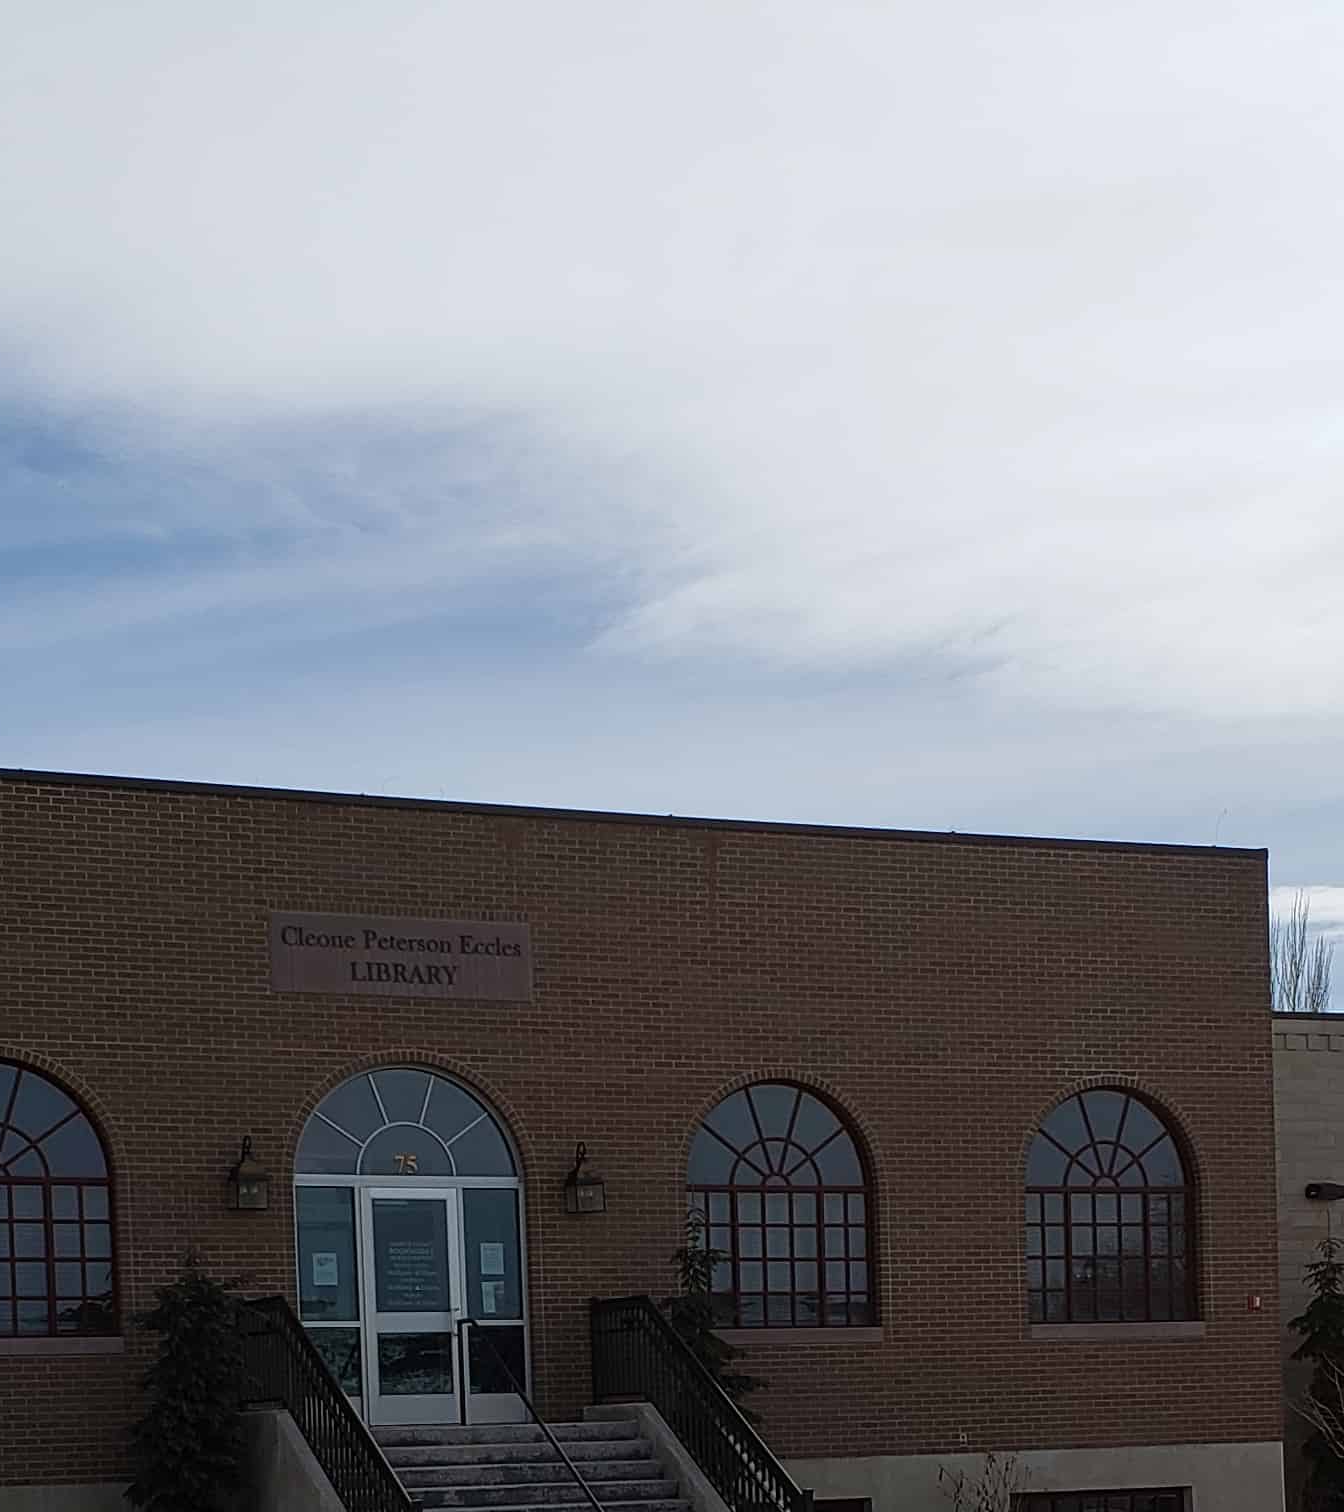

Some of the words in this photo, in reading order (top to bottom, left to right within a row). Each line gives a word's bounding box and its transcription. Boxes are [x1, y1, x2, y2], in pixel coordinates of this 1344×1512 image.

[281, 926, 356, 949] Cleone
[362, 930, 453, 953] Peterson
[459, 936, 522, 957] Eccles
[350, 962, 459, 986] LIBRARY
[394, 1154, 418, 1174] 75
